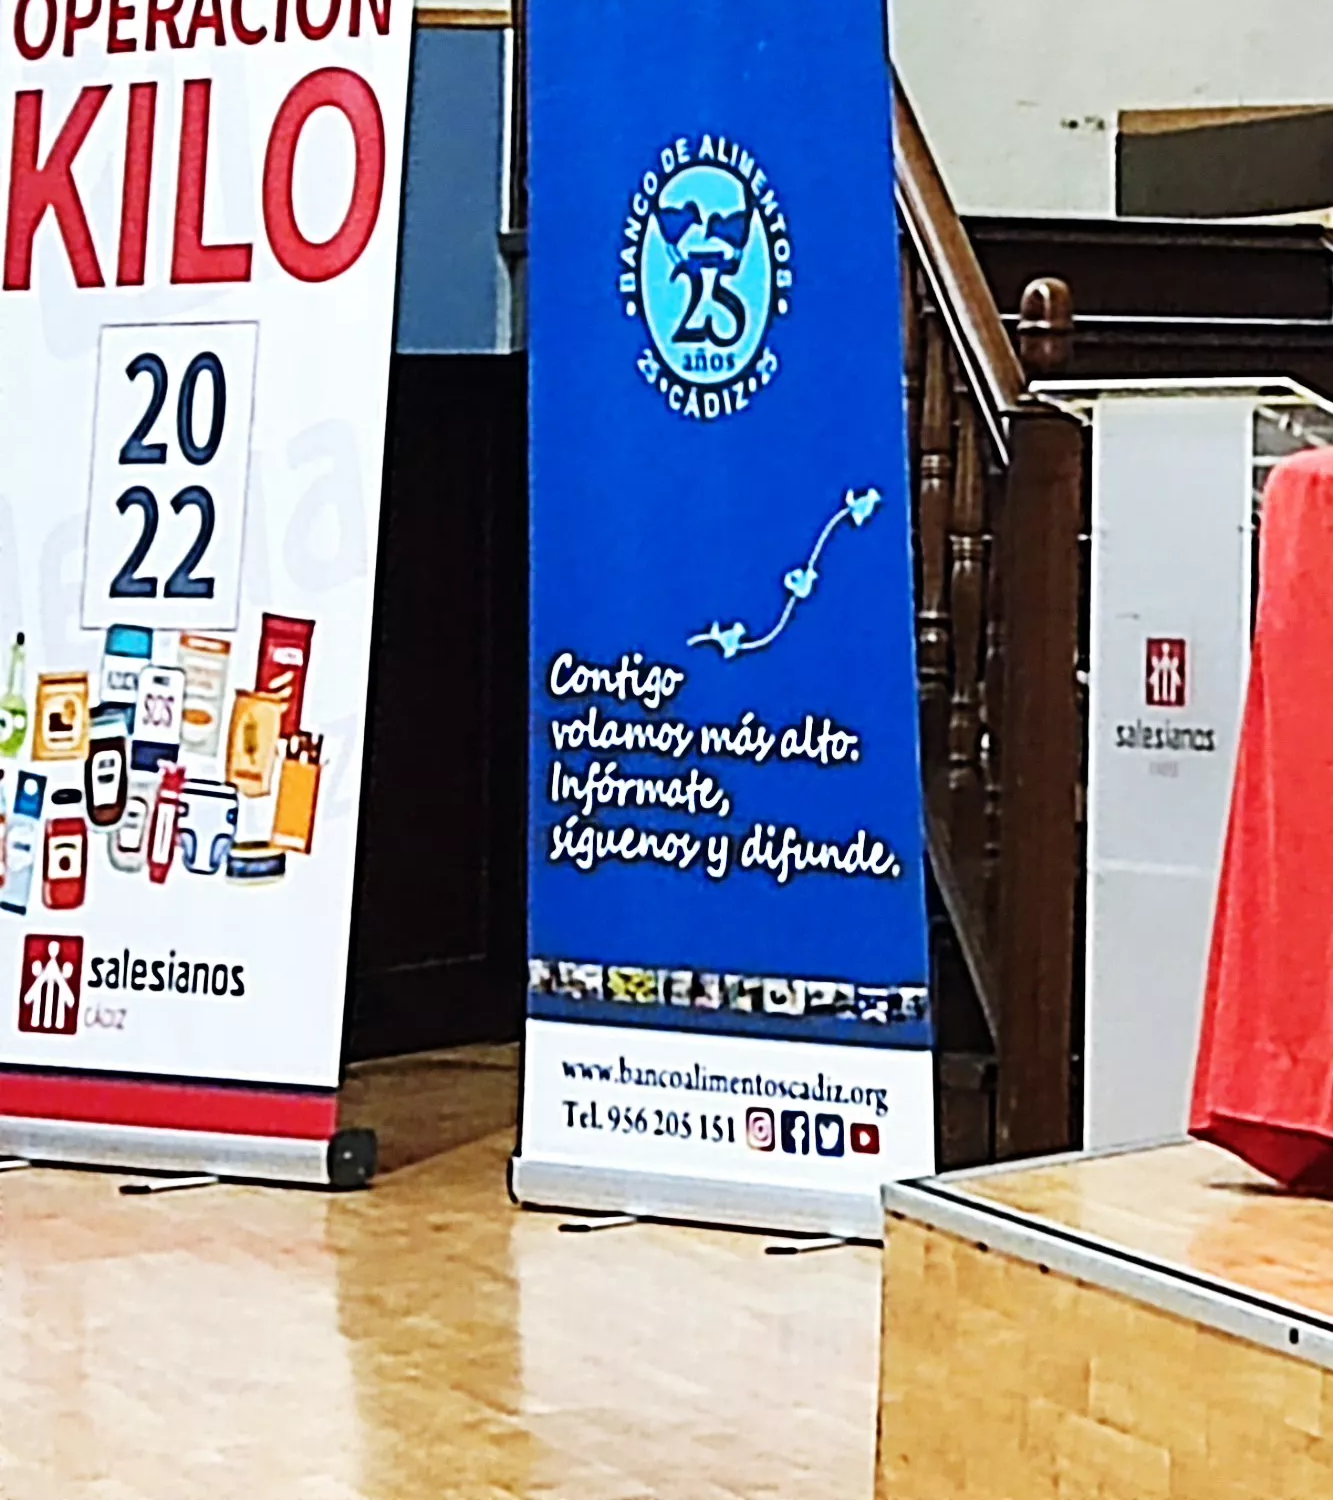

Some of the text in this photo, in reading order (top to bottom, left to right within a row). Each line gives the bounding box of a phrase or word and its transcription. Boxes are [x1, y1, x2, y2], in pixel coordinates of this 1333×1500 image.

[2, 66, 386, 291] KILO
[619, 134, 793, 293] BANCO DE ALIMENTOS
[670, 255, 747, 348] 25
[682, 348, 736, 372] años
[118, 351, 227, 466] 20
[109, 485, 216, 599] 22
[550, 653, 684, 709] Contigo
[551, 706, 860, 765] volamos más alto.
[551, 761, 730, 817] Infórmate,
[550, 815, 901, 883] síguenos y difunde.
[87, 948, 245, 997] salesianos
[561, 1056, 889, 1117] www.bancoalimentoscadiz.org
[607, 1105, 648, 1134] 956
[653, 1109, 692, 1139] 205
[700, 1114, 735, 1143] 151
